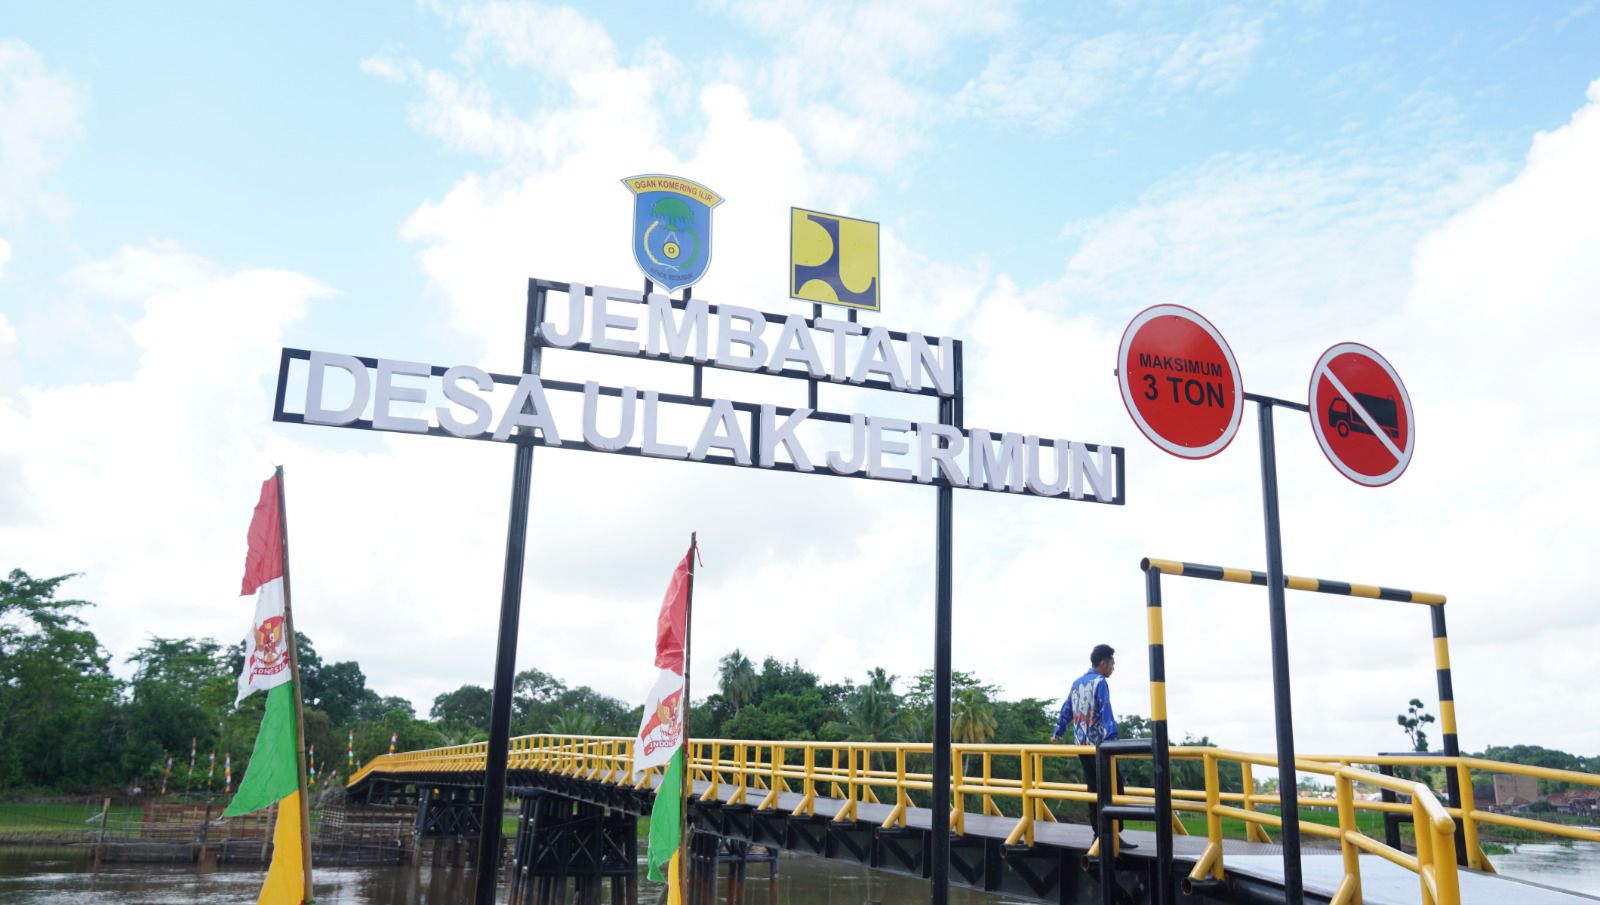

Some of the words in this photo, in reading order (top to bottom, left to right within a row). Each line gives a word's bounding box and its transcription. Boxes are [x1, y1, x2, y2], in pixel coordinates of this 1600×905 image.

[634, 179, 656, 189] OGAN
[657, 180, 698, 194] KOMERING
[698, 189, 713, 202] ILIR
[541, 282, 954, 396] JEMBATAN
[1139, 352, 1223, 378] MAKSIMUM
[1143, 373, 1158, 401] 3
[1166, 376, 1225, 409] TON
[304, 350, 562, 447] DESA
[582, 381, 816, 472] ULAK
[826, 412, 1113, 503] JERMUN
